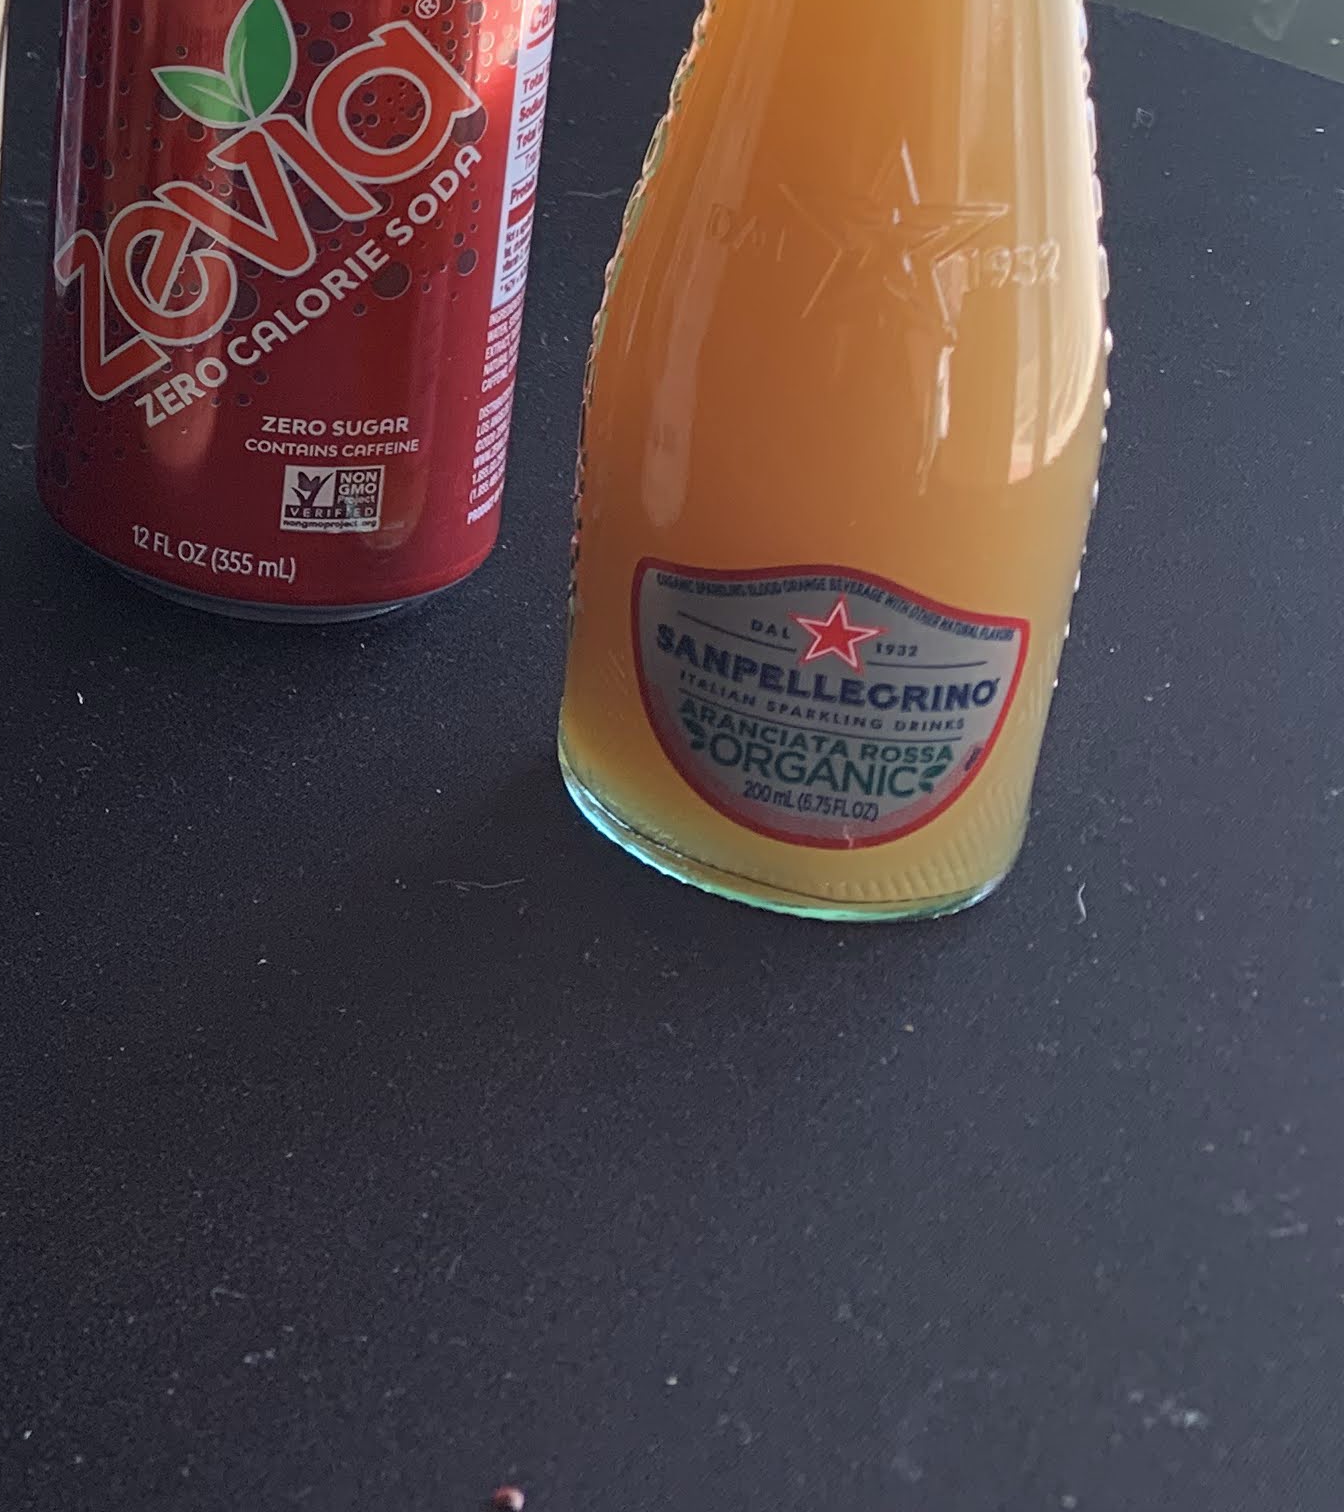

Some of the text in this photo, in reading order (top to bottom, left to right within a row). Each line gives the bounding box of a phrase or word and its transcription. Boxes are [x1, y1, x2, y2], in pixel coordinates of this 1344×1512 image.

[133, 357, 228, 428] ZERO
[227, 239, 391, 365] CALORIE
[385, 143, 483, 244] SODA
[262, 416, 408, 436] ZERO SUGAR
[245, 439, 419, 458] CONTAINS CAFFEINE
[338, 484, 376, 495] GMO
[341, 472, 377, 483] NON
[290, 507, 374, 518] VERIFIED
[337, 495, 375, 505] Project
[131, 524, 296, 583] 12 FL OZ (355 mL)
[783, 577, 826, 593] ORANGE
[829, 577, 886, 603] BEVERAGE
[885, 592, 911, 613] WITH
[911, 603, 942, 624] OTHER
[751, 619, 791, 639] DAL
[876, 642, 918, 657] 1932
[656, 623, 997, 713] SANPELLEGRINO
[679, 670, 964, 732] ITALIAN SPARKLING DRINKS
[679, 698, 849, 759] ARANCIATA
[860, 744, 954, 764] ROSSA
[710, 733, 919, 798] ORGANIC
[743, 780, 773, 802] 200
[774, 788, 796, 808] mL
[832, 798, 851, 818] FL
[852, 800, 879, 822] OZ)
